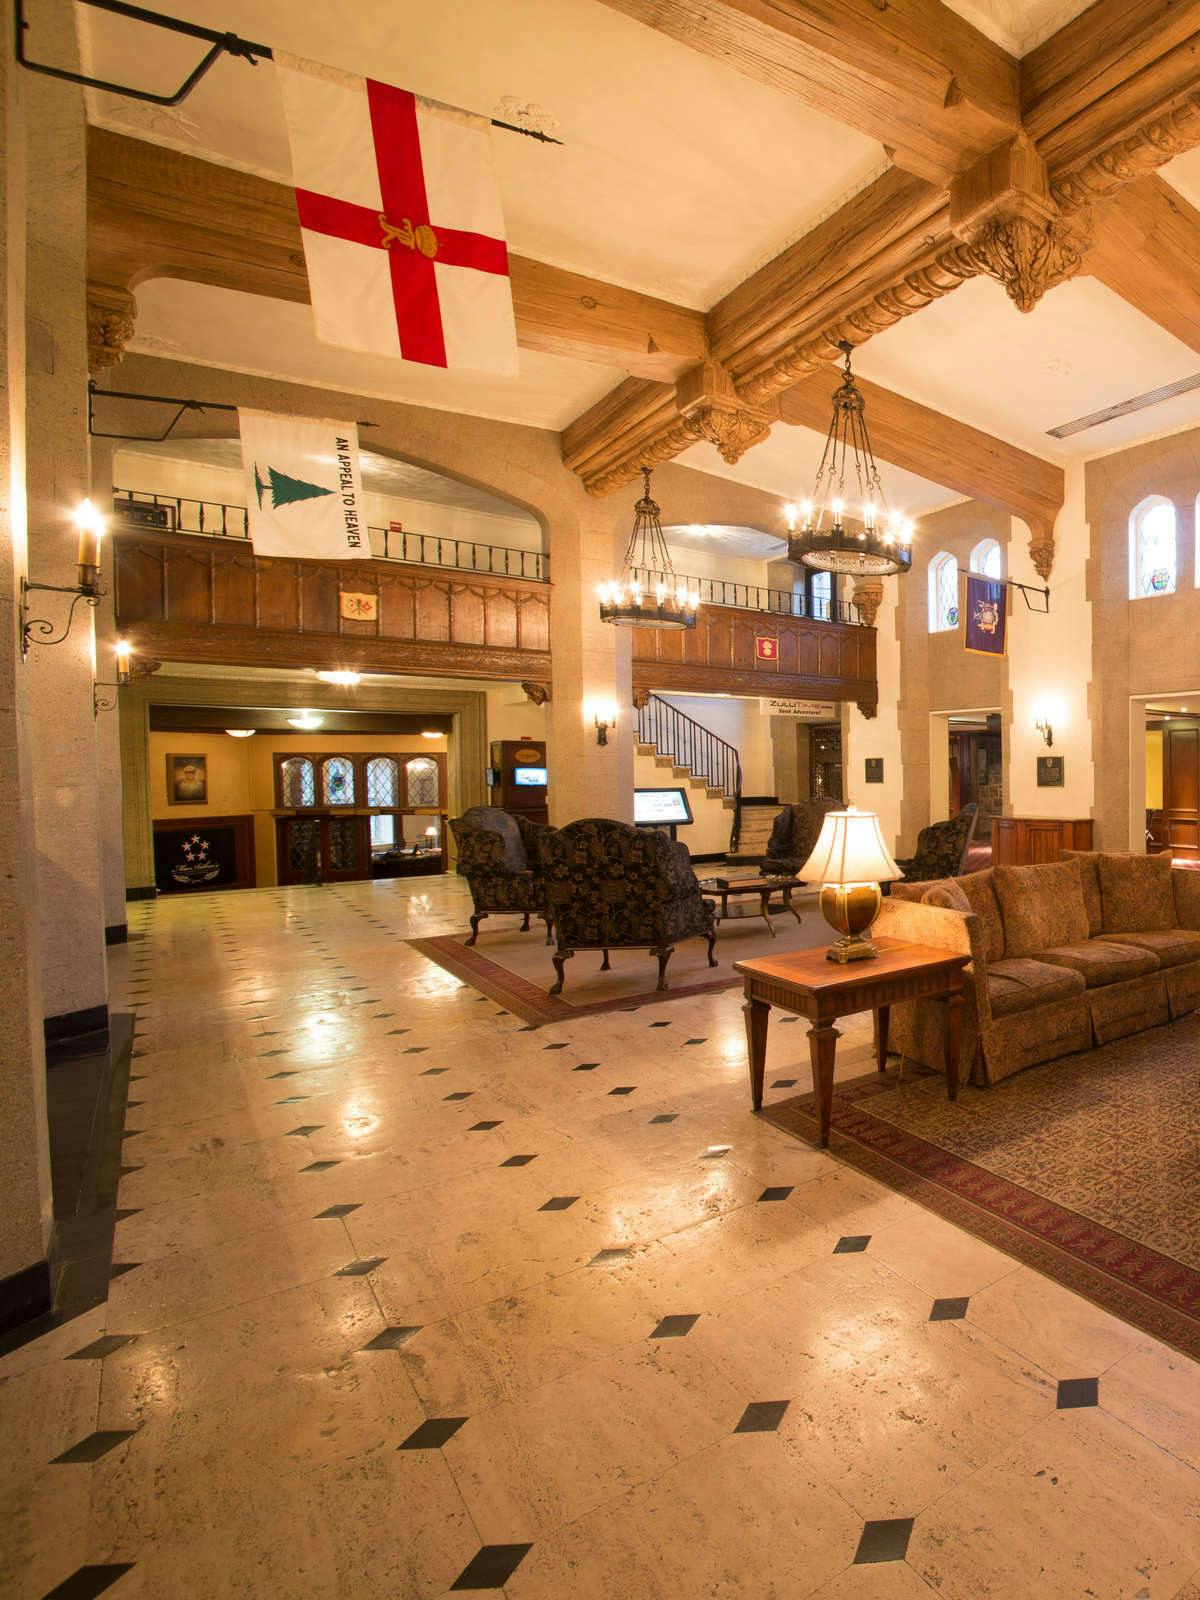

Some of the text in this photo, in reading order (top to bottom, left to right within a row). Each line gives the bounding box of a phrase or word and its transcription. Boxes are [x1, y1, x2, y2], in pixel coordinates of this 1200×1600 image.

[336, 437, 361, 548] AN APPEAL TO HEAVEN
